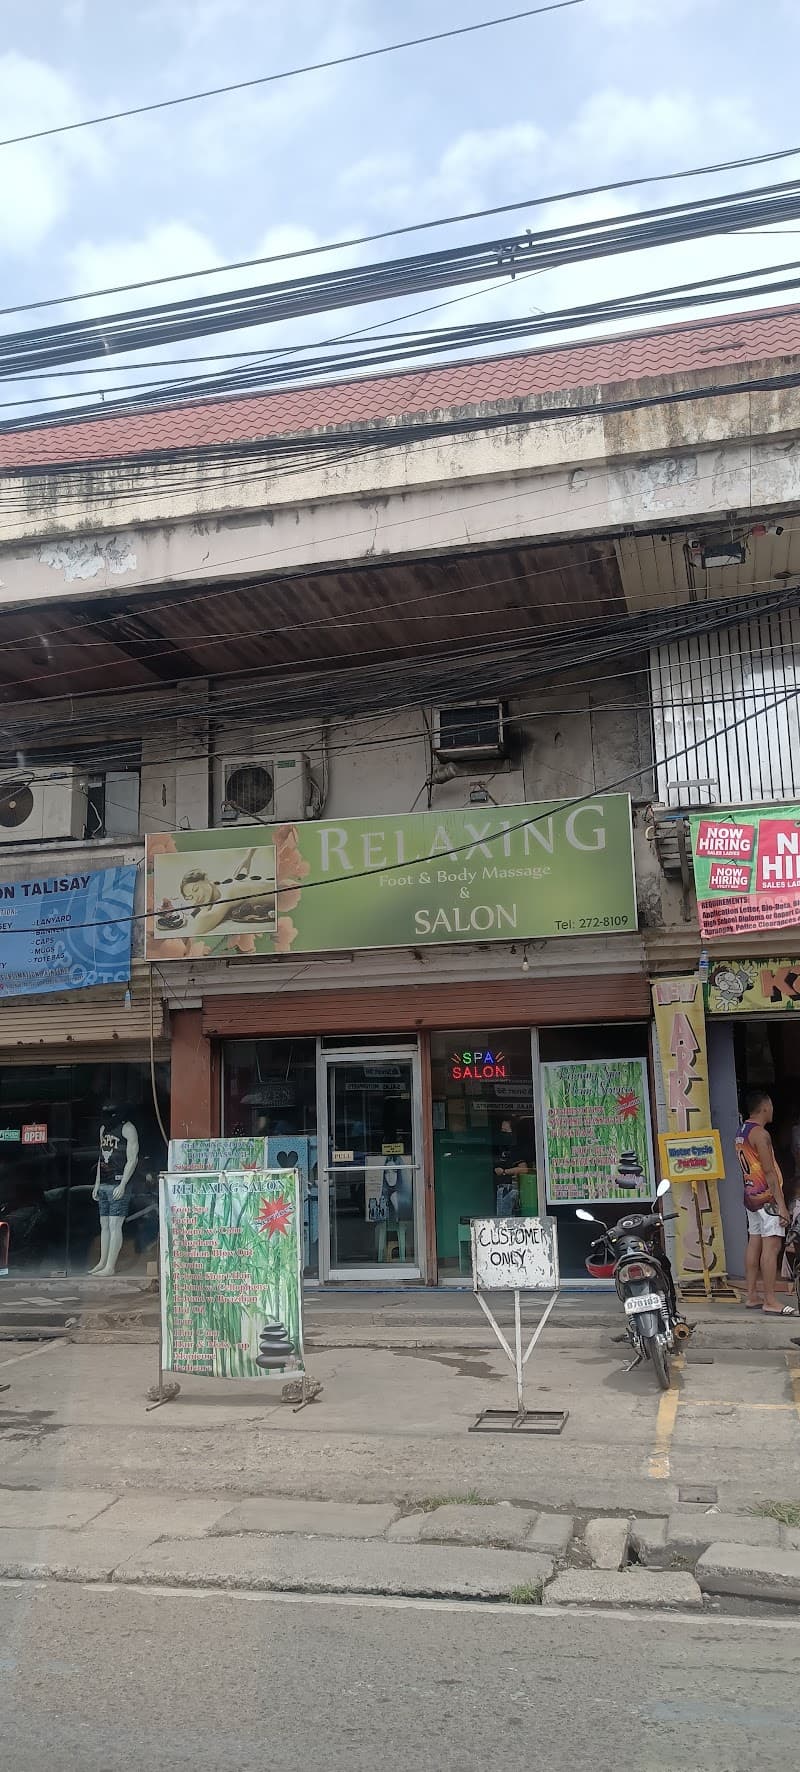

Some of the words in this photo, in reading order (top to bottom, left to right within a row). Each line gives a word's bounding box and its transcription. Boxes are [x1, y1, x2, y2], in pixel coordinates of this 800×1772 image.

[318, 805, 607, 872] RELAXING
[707, 828, 743, 839] NOW
[699, 839, 751, 851] HIRING
[379, 873, 414, 887] Foot
[418, 872, 431, 884] &
[437, 868, 477, 885] Body
[481, 865, 551, 883] Massage
[717, 868, 743, 876] NOW
[21, 876, 91, 896] TALISAY
[711, 876, 748, 885] HIRING
[459, 887, 471, 899] &
[415, 904, 518, 934] SALON
[554, 918, 575, 931] Tel:
[578, 915, 628, 929] 272-8109
[462, 1051, 495, 1064] SPA
[452, 1066, 505, 1078] SALON
[25, 1132, 46, 1142] OPEN
[668, 1148, 691, 1157] Motor
[691, 1145, 713, 1156] Cycle
[678, 1158, 707, 1168] Parking
[172, 1182, 239, 1195] RELAXING
[244, 1180, 285, 1193] SALON
[479, 1227, 548, 1246] CUSTOMER
[490, 1250, 526, 1267] ONLY
